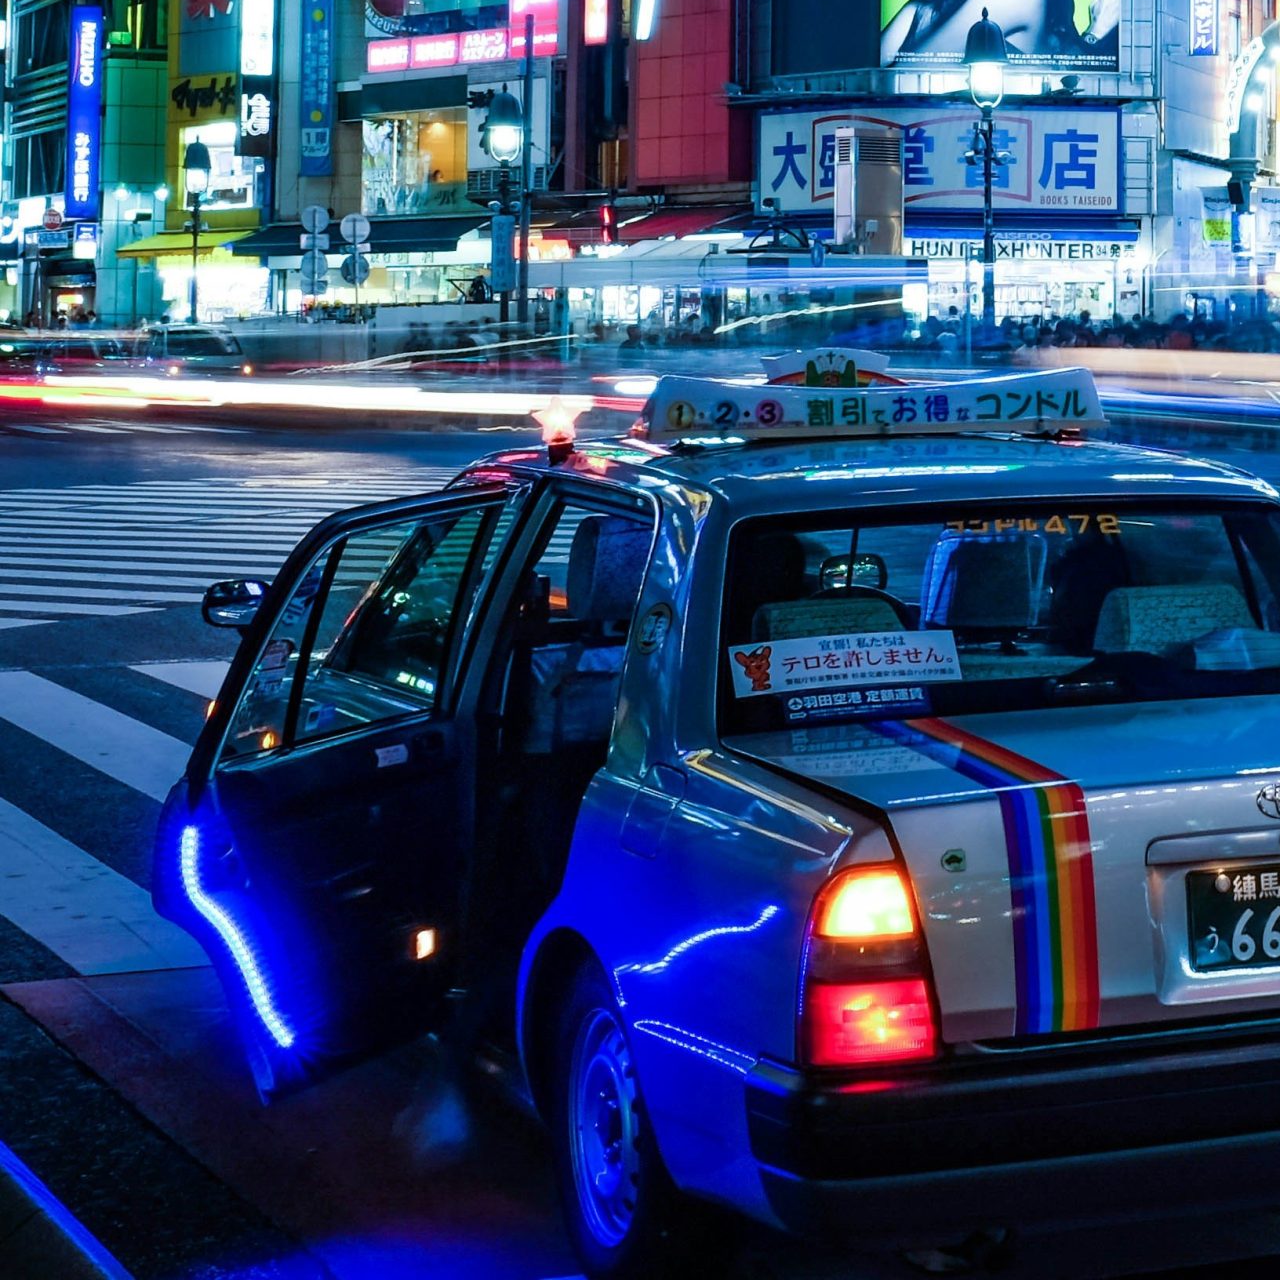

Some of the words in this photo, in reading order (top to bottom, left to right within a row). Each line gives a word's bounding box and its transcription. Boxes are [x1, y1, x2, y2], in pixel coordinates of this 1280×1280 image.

[80, 21, 97, 87] MIZUHO
[1040, 195, 1069, 206] BOOKS
[1073, 195, 1112, 206] TAISEIDO
[1044, 514, 1121, 534] 472
[856, 636, 906, 648] 私たちは
[782, 648, 953, 673] テロを許しません。
[802, 689, 862, 708] 羽田空港
[866, 686, 924, 703] 定額運賃
